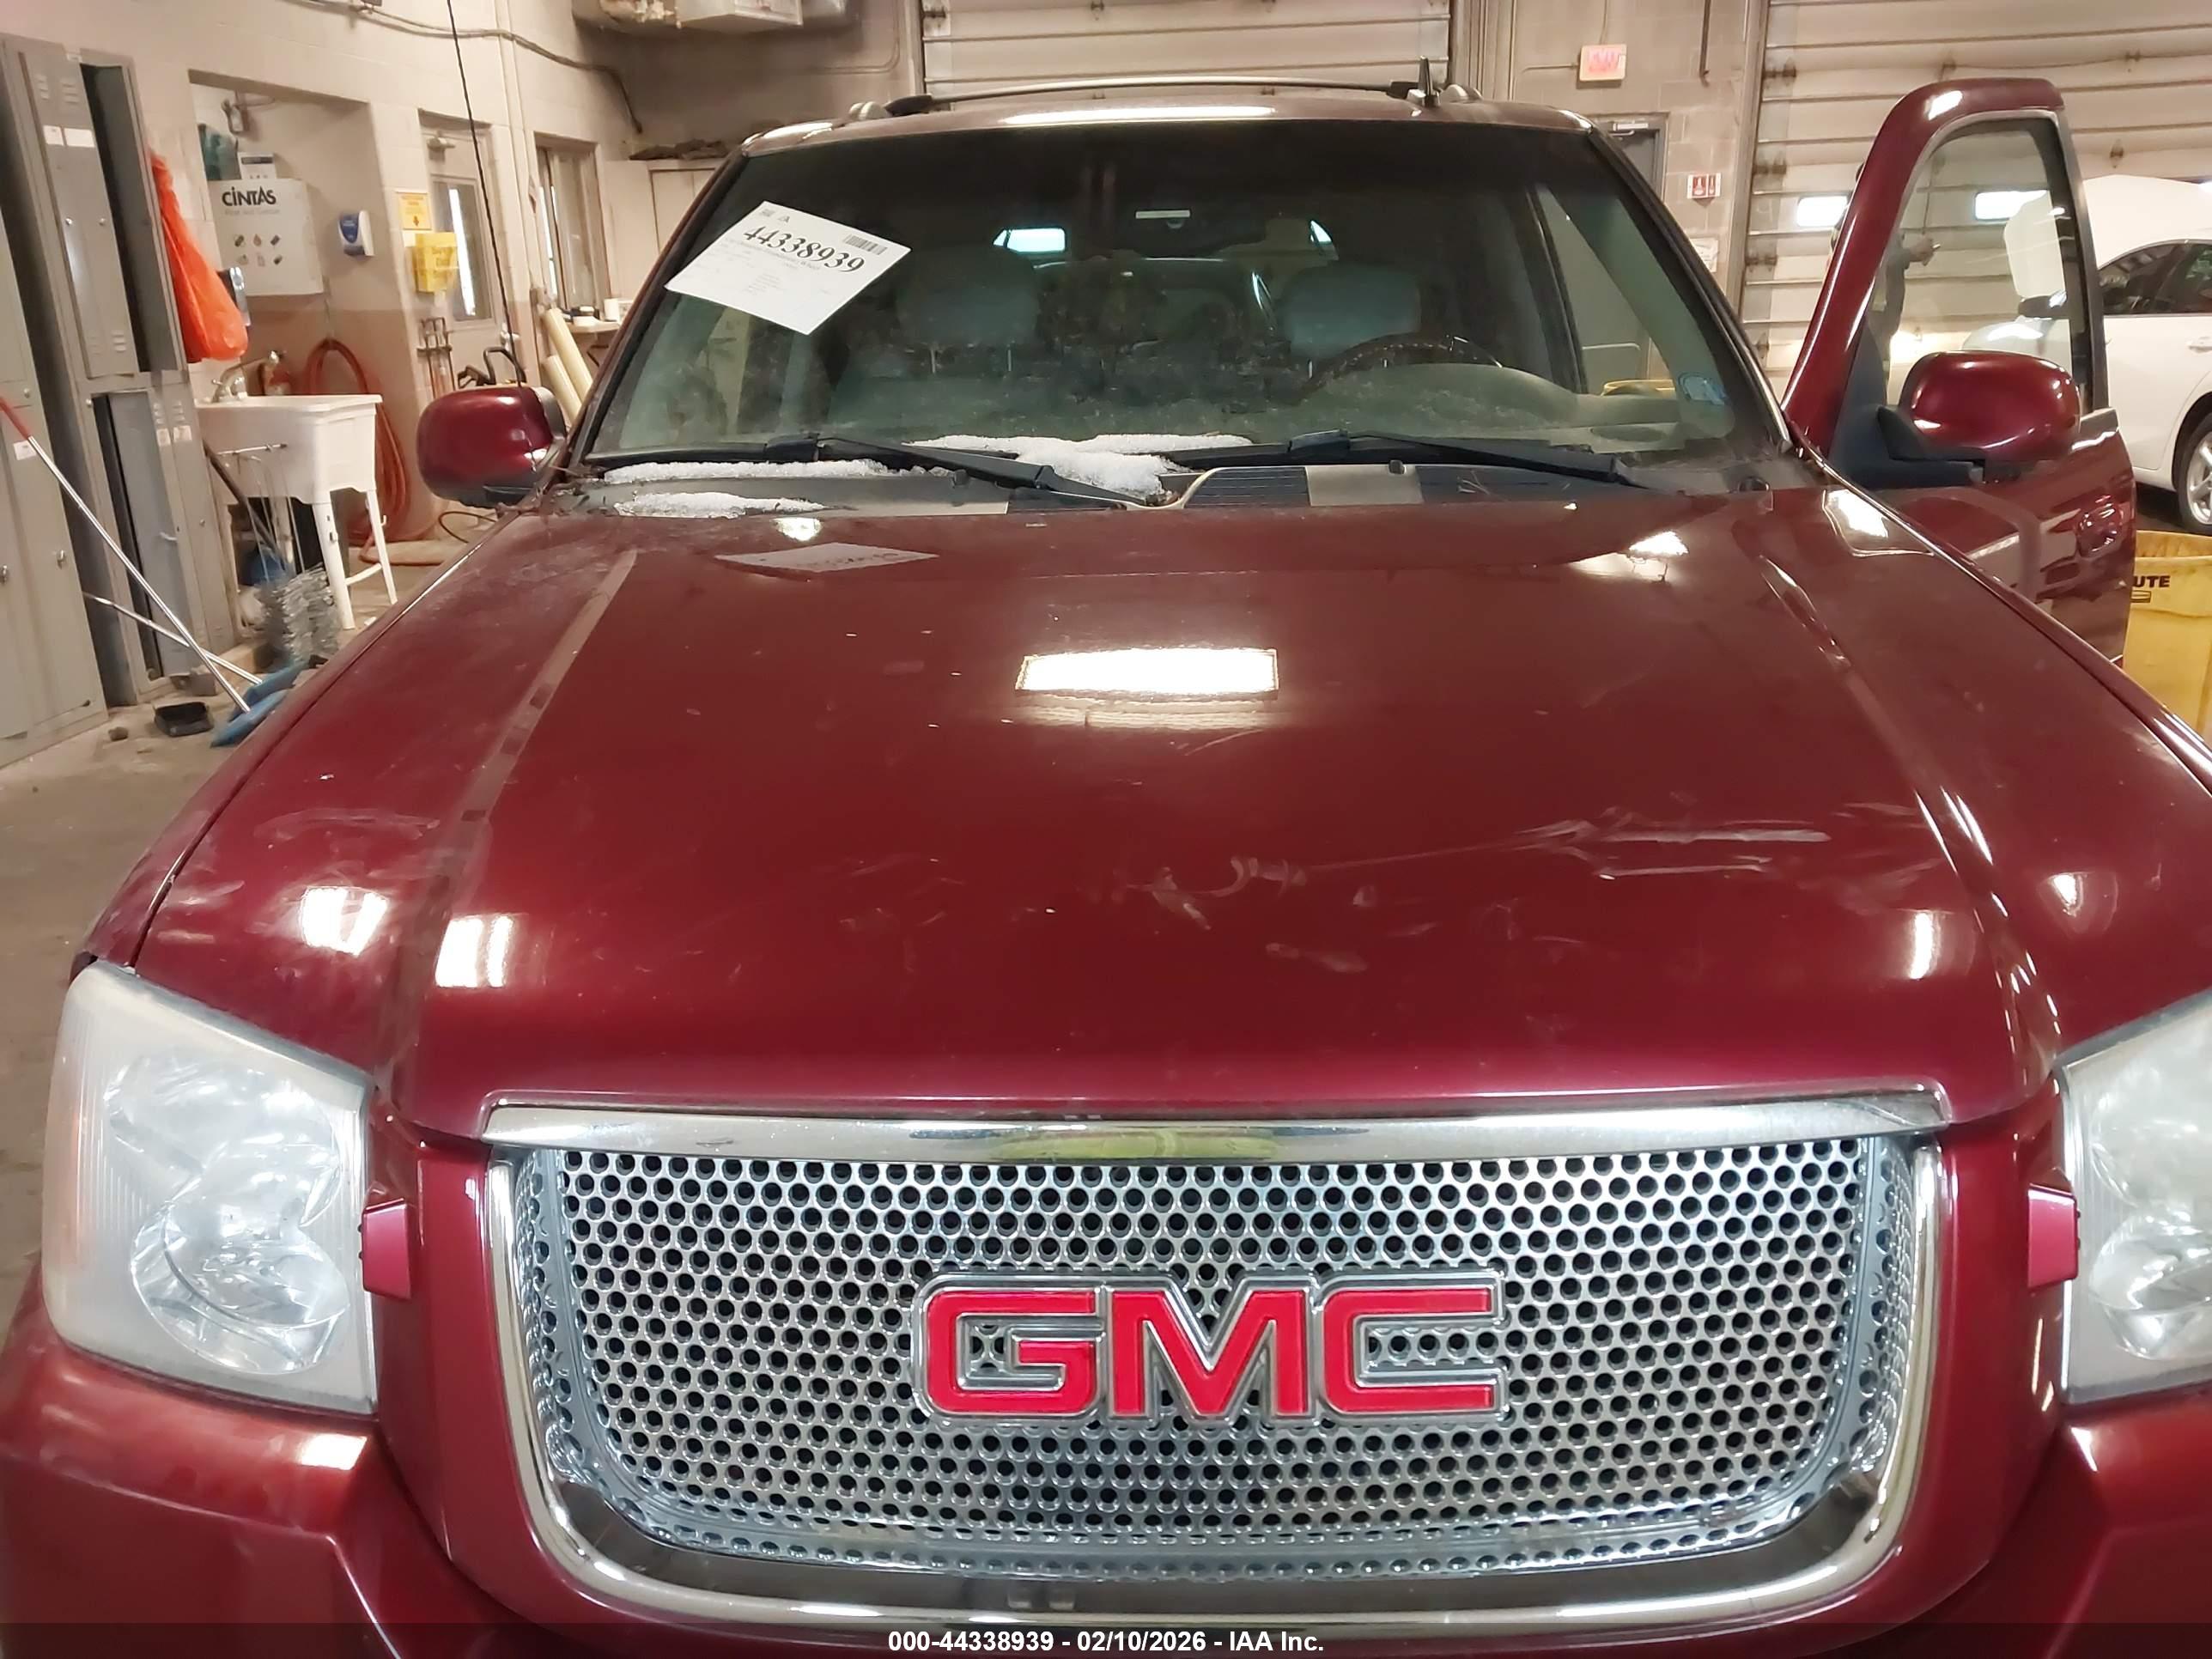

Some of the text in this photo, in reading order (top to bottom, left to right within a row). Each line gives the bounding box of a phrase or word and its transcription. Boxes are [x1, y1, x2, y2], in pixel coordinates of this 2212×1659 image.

[744, 226, 866, 273] 44338939
[2133, 575, 2170, 587] UTE
[912, 1271, 1510, 1427] GMC
